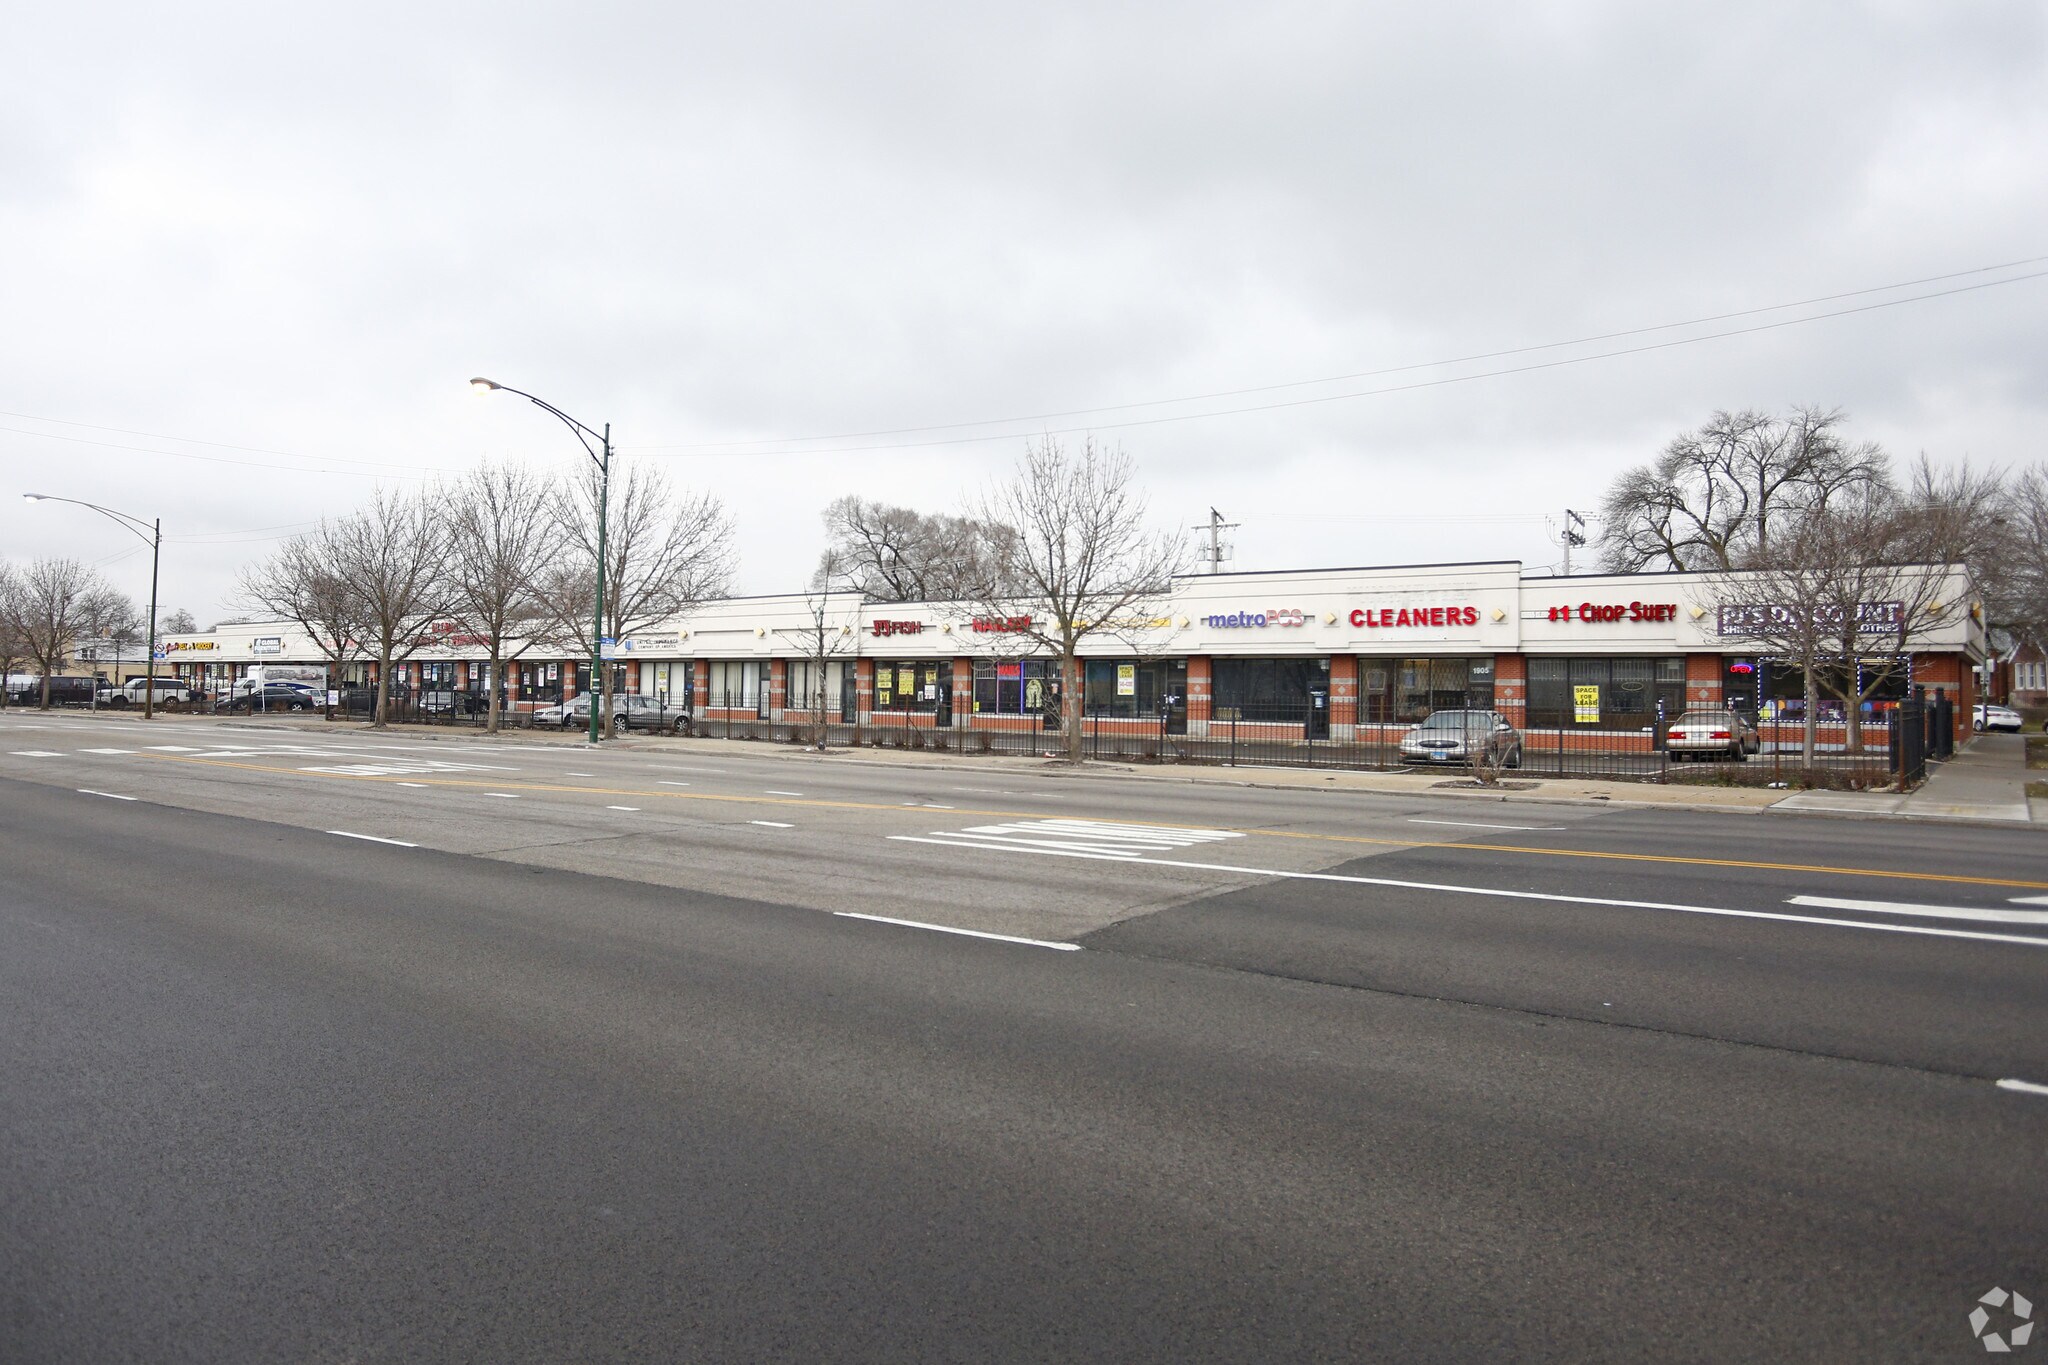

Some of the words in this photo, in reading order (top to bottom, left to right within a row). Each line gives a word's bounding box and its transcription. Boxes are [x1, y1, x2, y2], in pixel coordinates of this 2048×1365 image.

[1208, 609, 1304, 628] metroPCS
[1350, 606, 1477, 627] CLEANERS
[1549, 605, 1568, 622] #1
[1770, 603, 1899, 623] DCOUNT
[1852, 623, 1900, 633] LOTHES
[1730, 665, 1751, 674] OPEN
